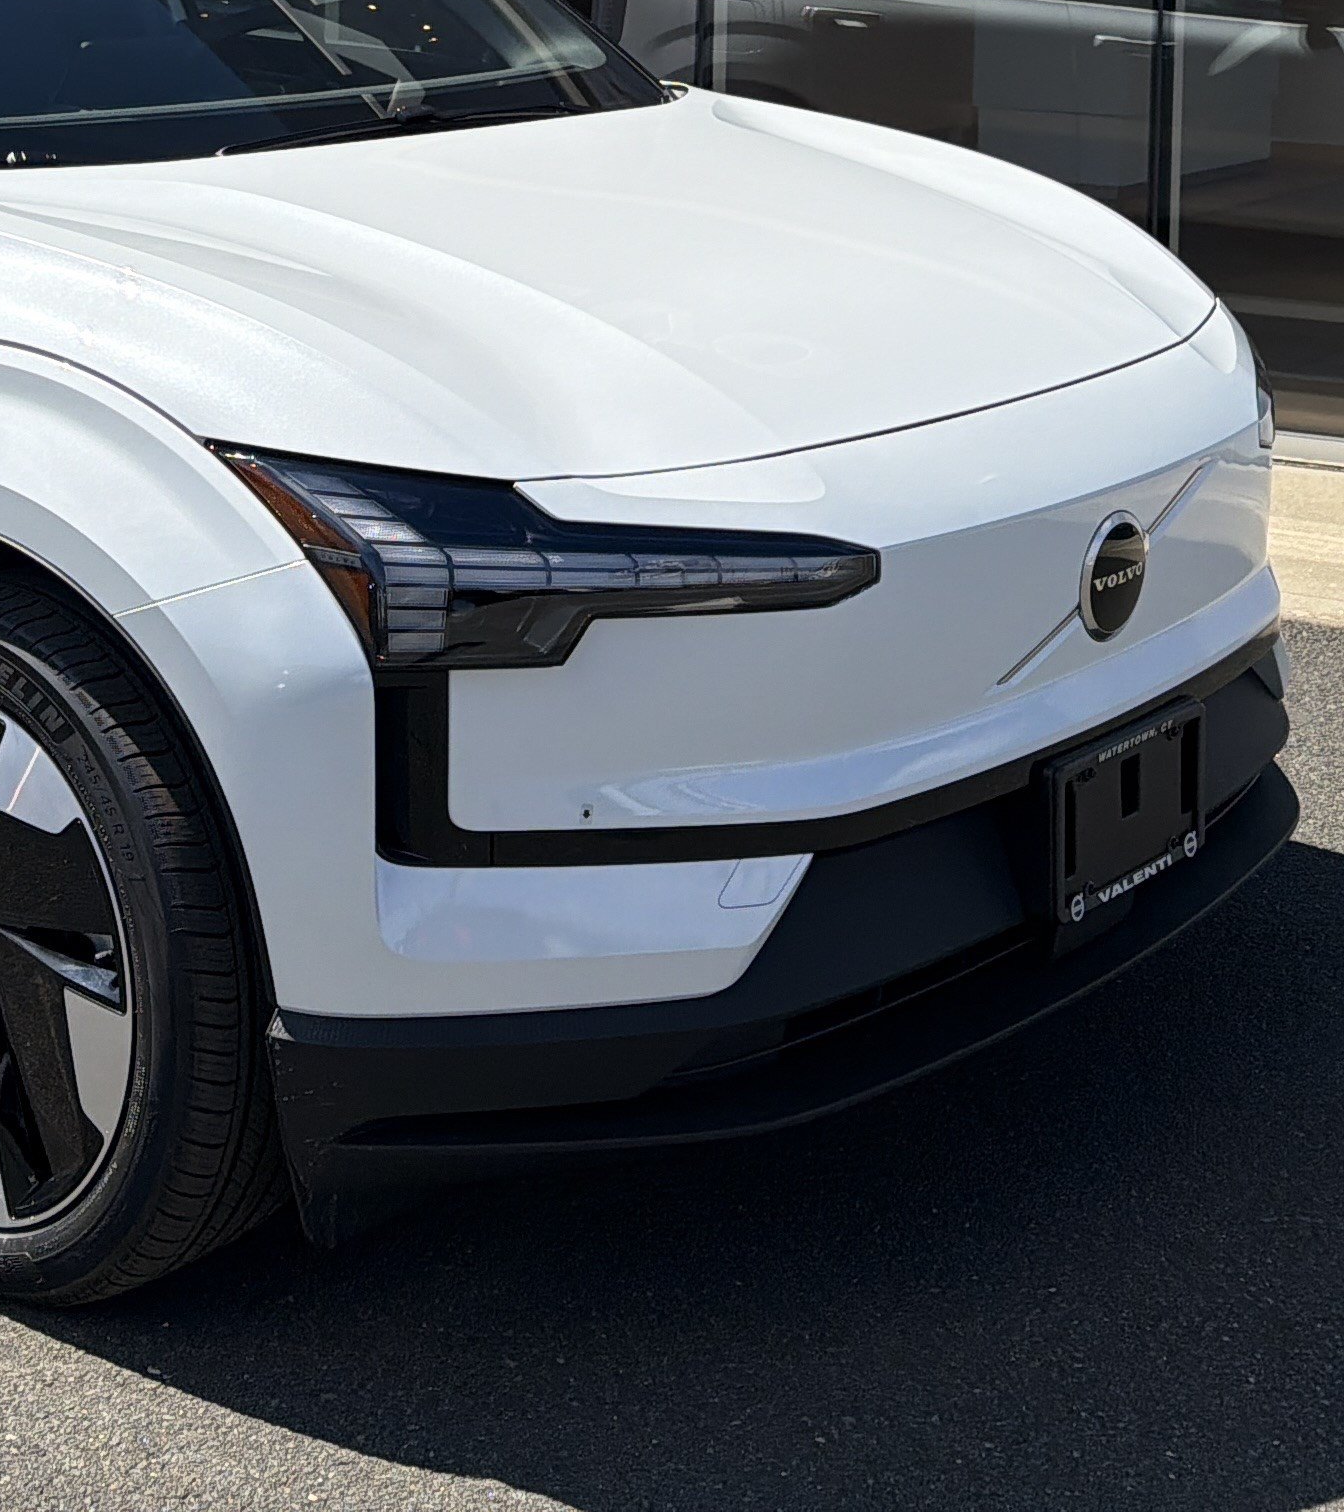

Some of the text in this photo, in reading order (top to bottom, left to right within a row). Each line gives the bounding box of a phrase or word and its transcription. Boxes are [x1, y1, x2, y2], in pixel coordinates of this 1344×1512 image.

[1093, 561, 1143, 592] VOLVO
[1098, 727, 1158, 764] WATERTOWN,
[1097, 854, 1173, 904] VALENTI
